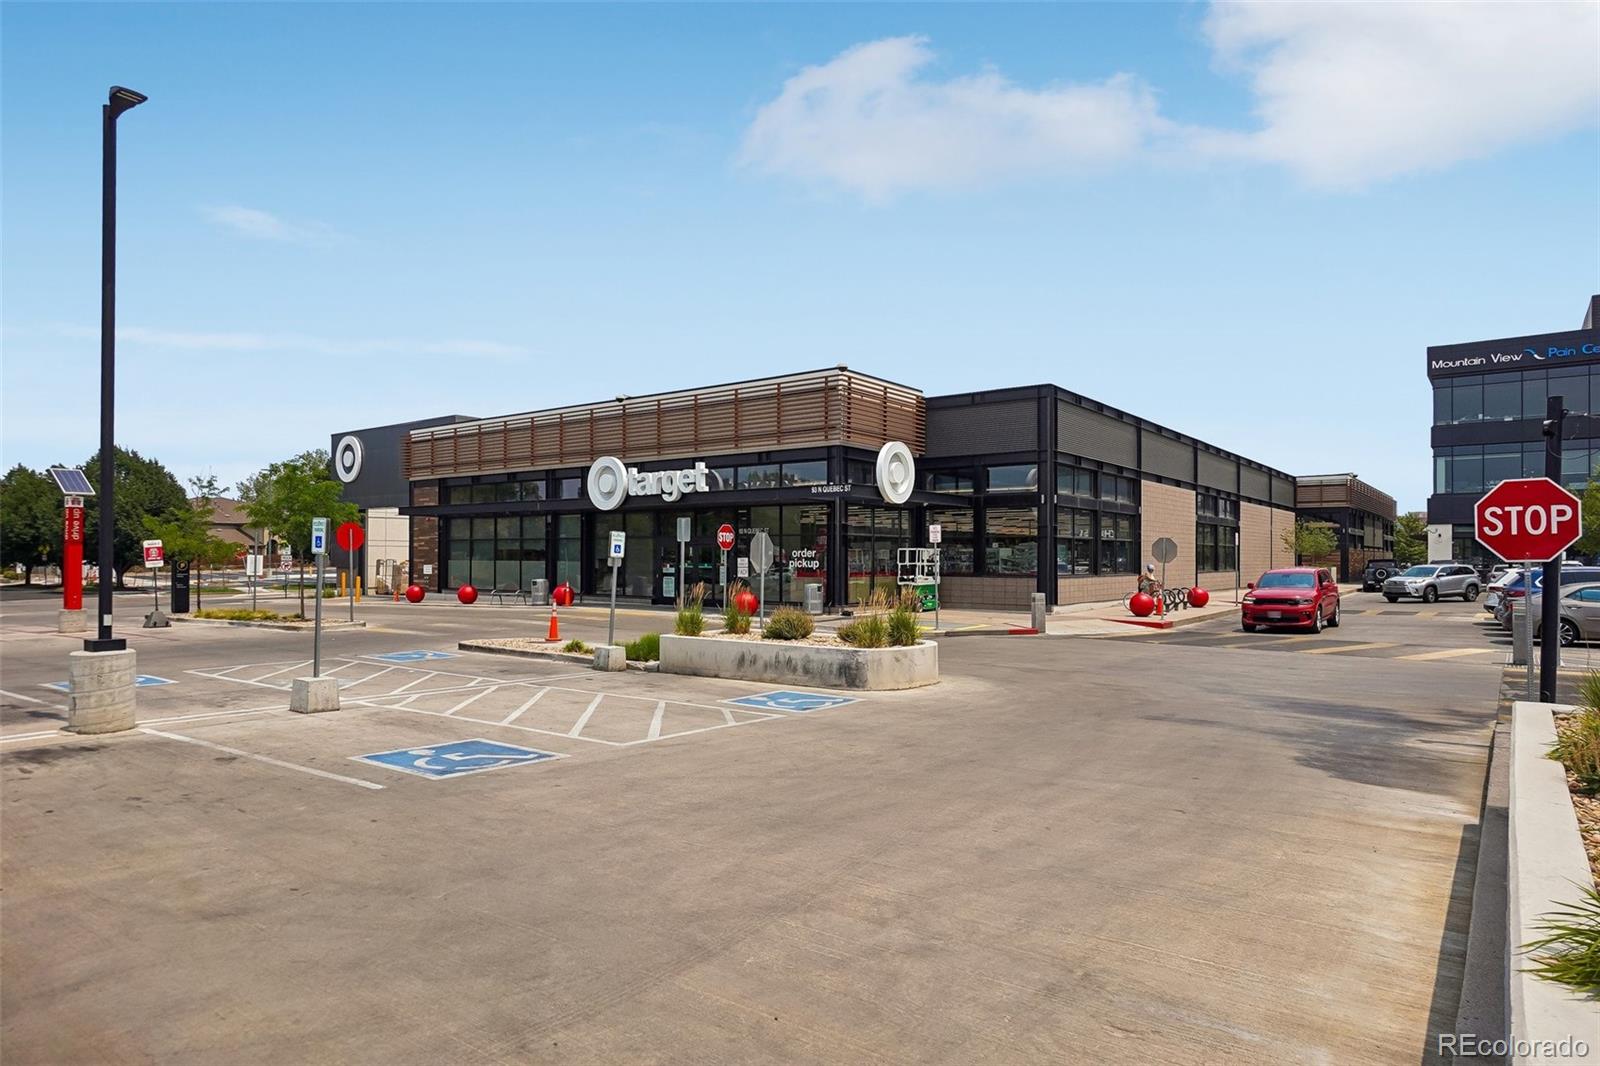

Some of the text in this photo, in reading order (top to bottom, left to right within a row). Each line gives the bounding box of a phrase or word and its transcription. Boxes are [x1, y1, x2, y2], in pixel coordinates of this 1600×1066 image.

[1431, 357, 1486, 369] Mountain
[1491, 353, 1523, 363] View
[1548, 347, 1576, 357] Pain
[627, 462, 710, 502] target
[822, 484, 844, 493] QUEBEC
[844, 484, 852, 492] ST
[71, 508, 82, 540] drive up
[1482, 504, 1573, 536] STOP
[718, 532, 735, 543] STOP
[791, 547, 817, 558] order
[789, 558, 820, 570] pickup
